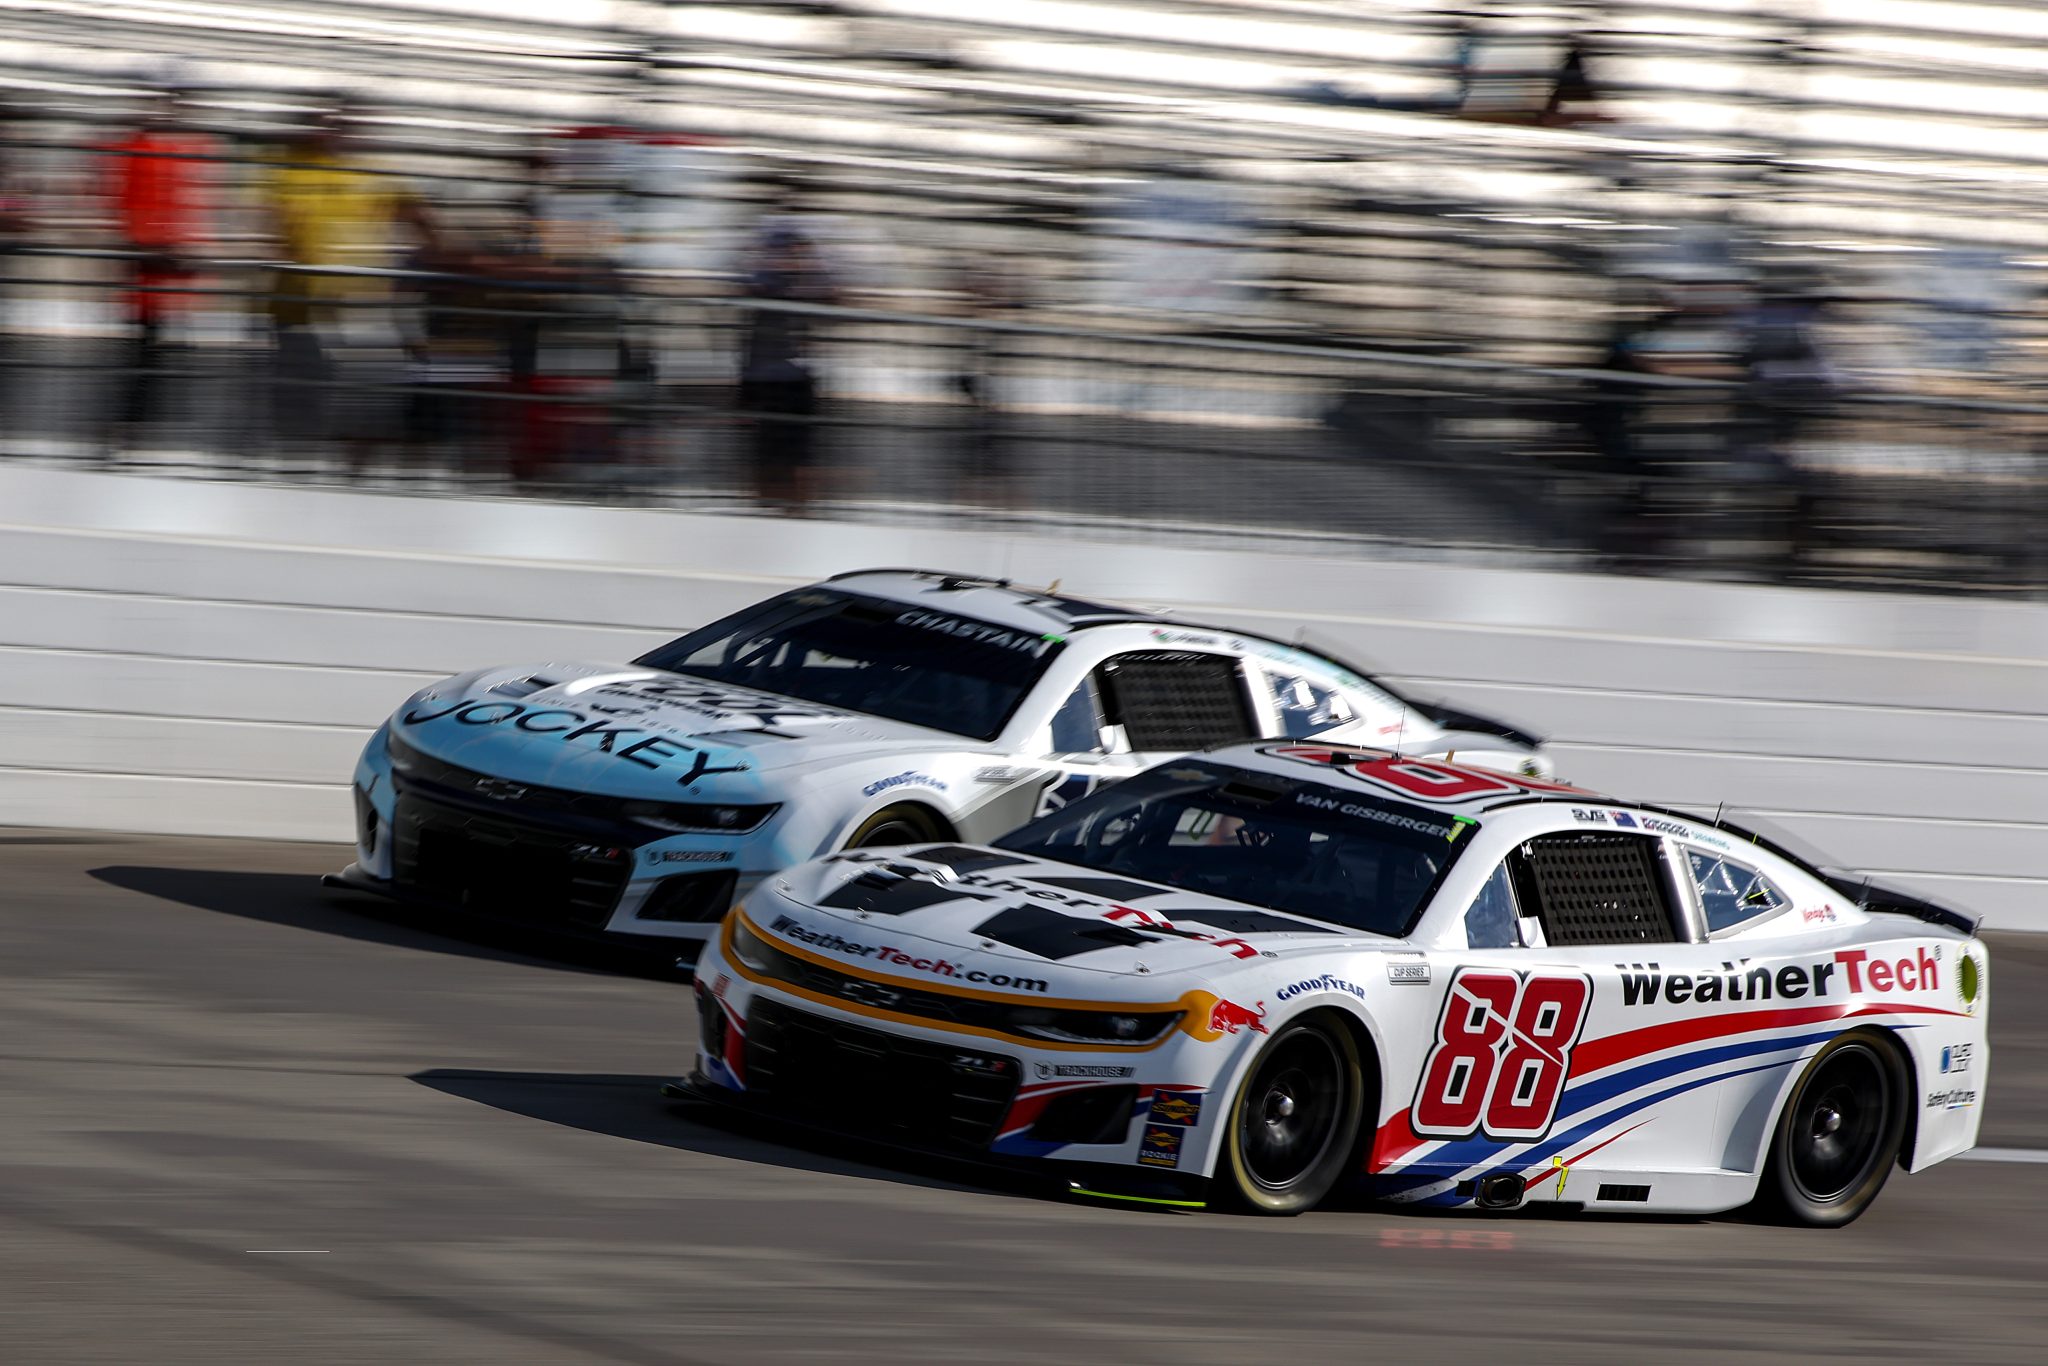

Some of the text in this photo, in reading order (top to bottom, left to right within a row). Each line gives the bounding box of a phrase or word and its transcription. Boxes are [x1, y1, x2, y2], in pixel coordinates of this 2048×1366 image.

[895, 610, 1056, 659] CHASTAIN
[403, 700, 750, 788] JOCKEY
[1296, 793, 1340, 810] VAN
[769, 914, 1048, 993] WeatherTech.com
[1615, 947, 1938, 1007] WeatherTech
[1276, 974, 1366, 1001] GOODYEAR
[1058, 1065, 1124, 1078] TRACKHOUSE
[1411, 965, 1594, 1143] 88
